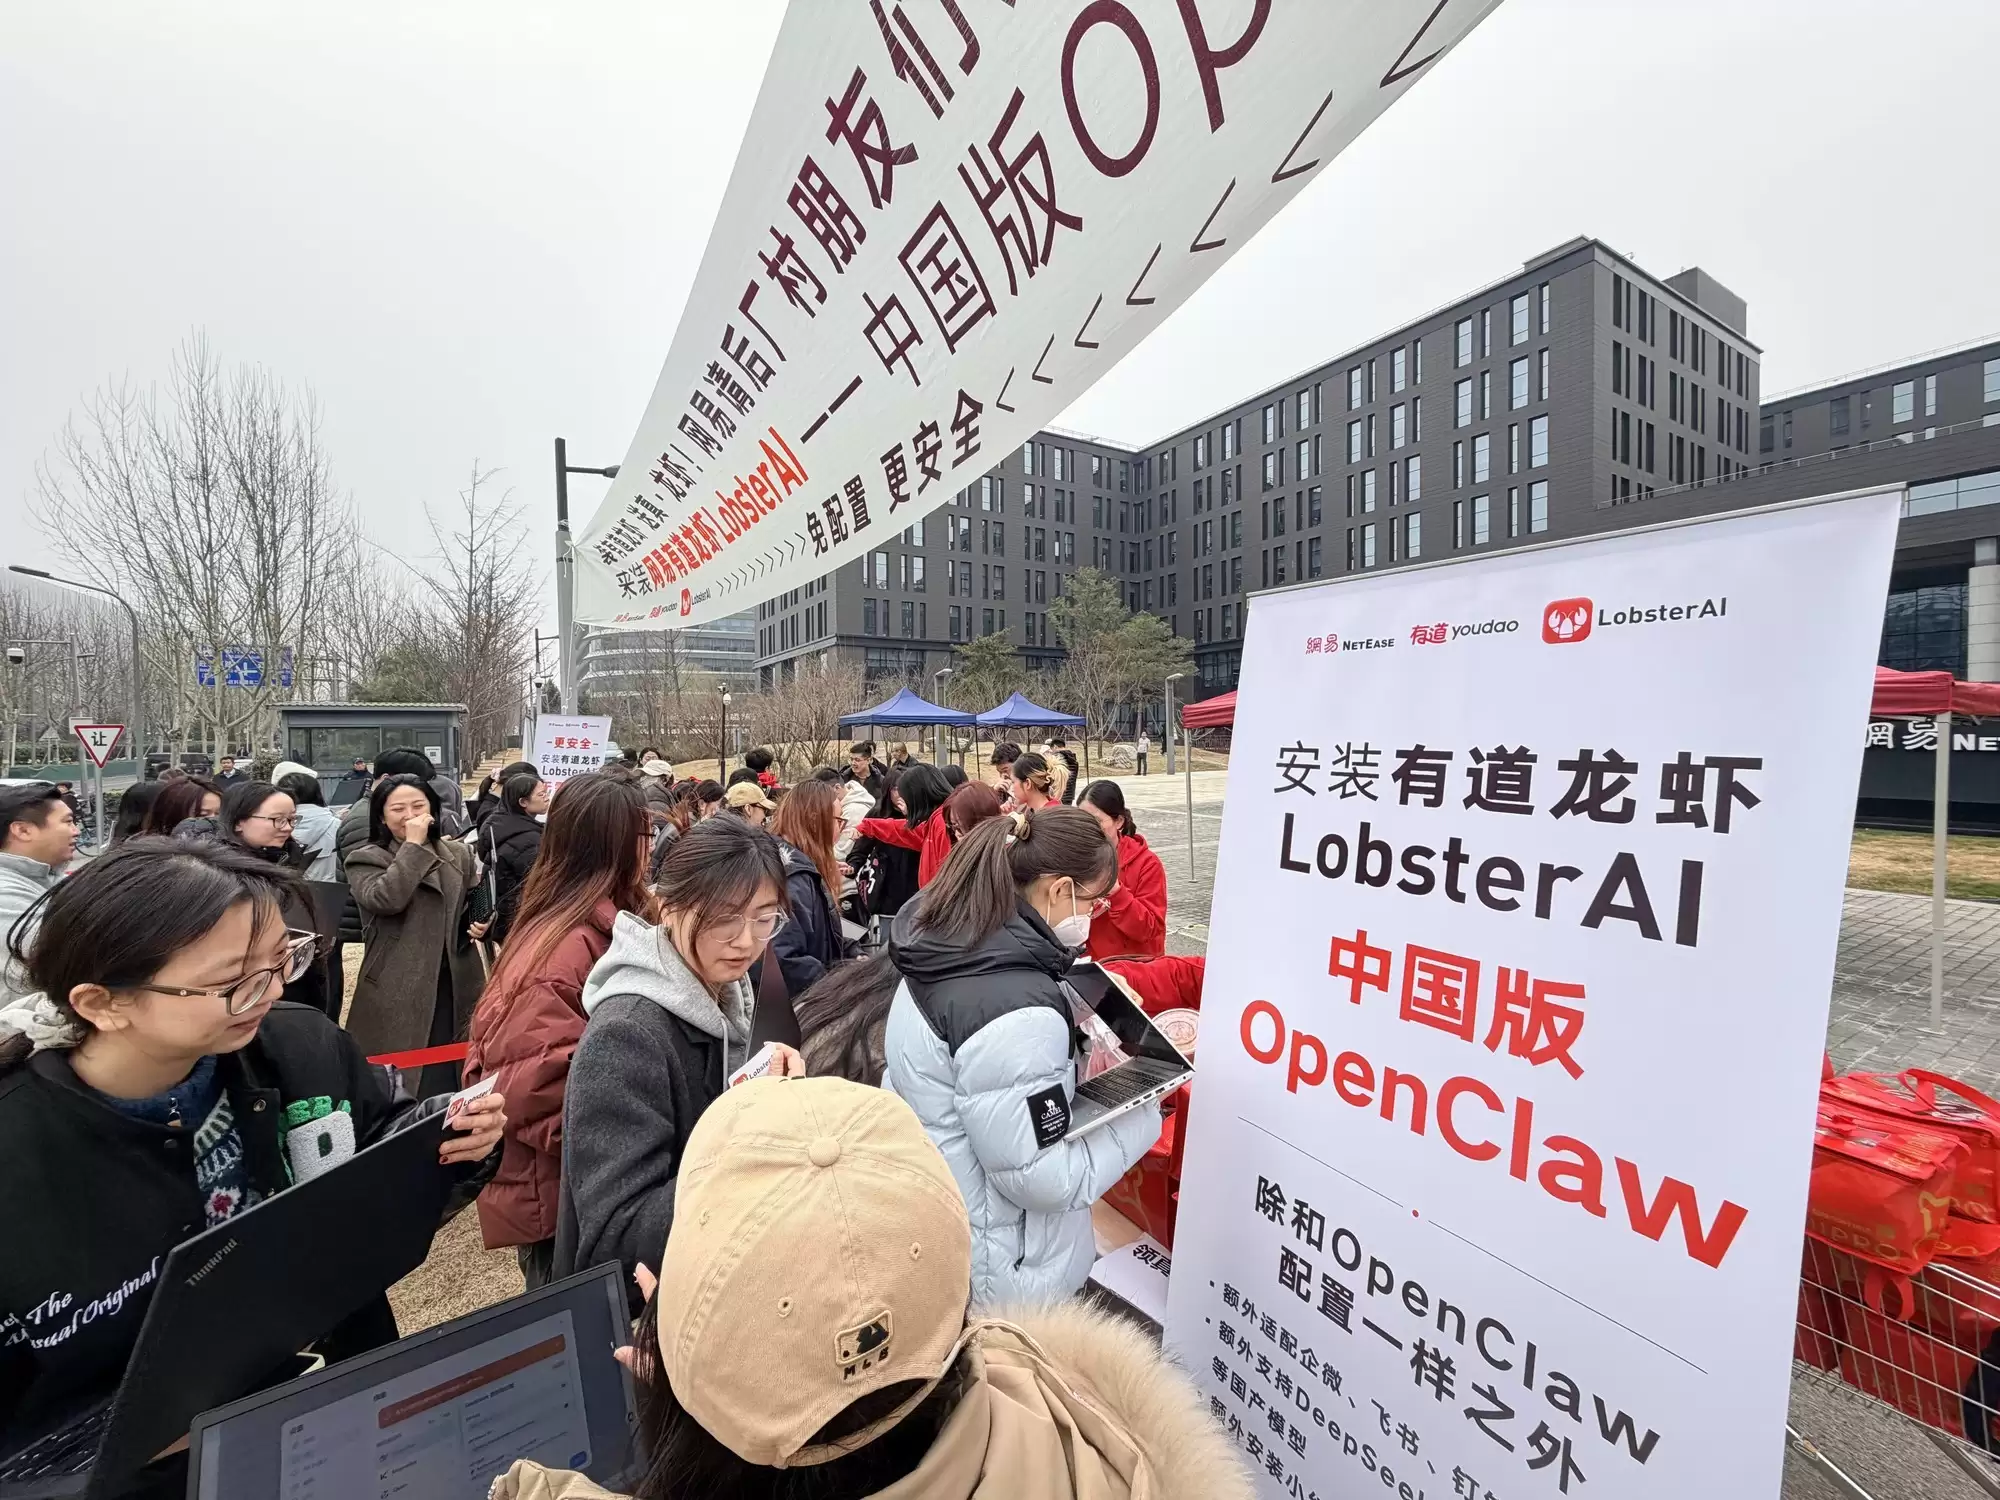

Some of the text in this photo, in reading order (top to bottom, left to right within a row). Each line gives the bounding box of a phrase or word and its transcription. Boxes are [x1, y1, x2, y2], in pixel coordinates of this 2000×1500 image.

[806, 388, 984, 558] 免配置 更安全
[1410, 622, 1448, 646] 有道
[1451, 618, 1519, 640] youdao
[1598, 597, 1727, 626] LobsterAI
[91, 731, 107, 746] 让
[541, 754, 600, 766] 安装有道龙虾
[554, 737, 591, 749] 更安全
[1953, 734, 2000, 751] NE
[1273, 740, 1764, 835] 安装有道龙虾
[1279, 812, 1706, 948] LobsterAI
[1328, 929, 1587, 1081] 中国版
[749, 1054, 774, 1079] Lobster
[1240, 1000, 1749, 1269] OpenClaw
[26, 1291, 73, 1325] The
[82, 1256, 160, 1324] Original
[1254, 1175, 1661, 1465] 除和OpenClaw
[844, 1346, 889, 1380] MLB
[1212, 1356, 1307, 1460] 等国产模型
[1223, 1283, 1499, 1500] 额外适配企微、飞书、钉
[1278, 1245, 1587, 1495] 配置一样之外
[1209, 1396, 1321, 1500] 额外安装小
